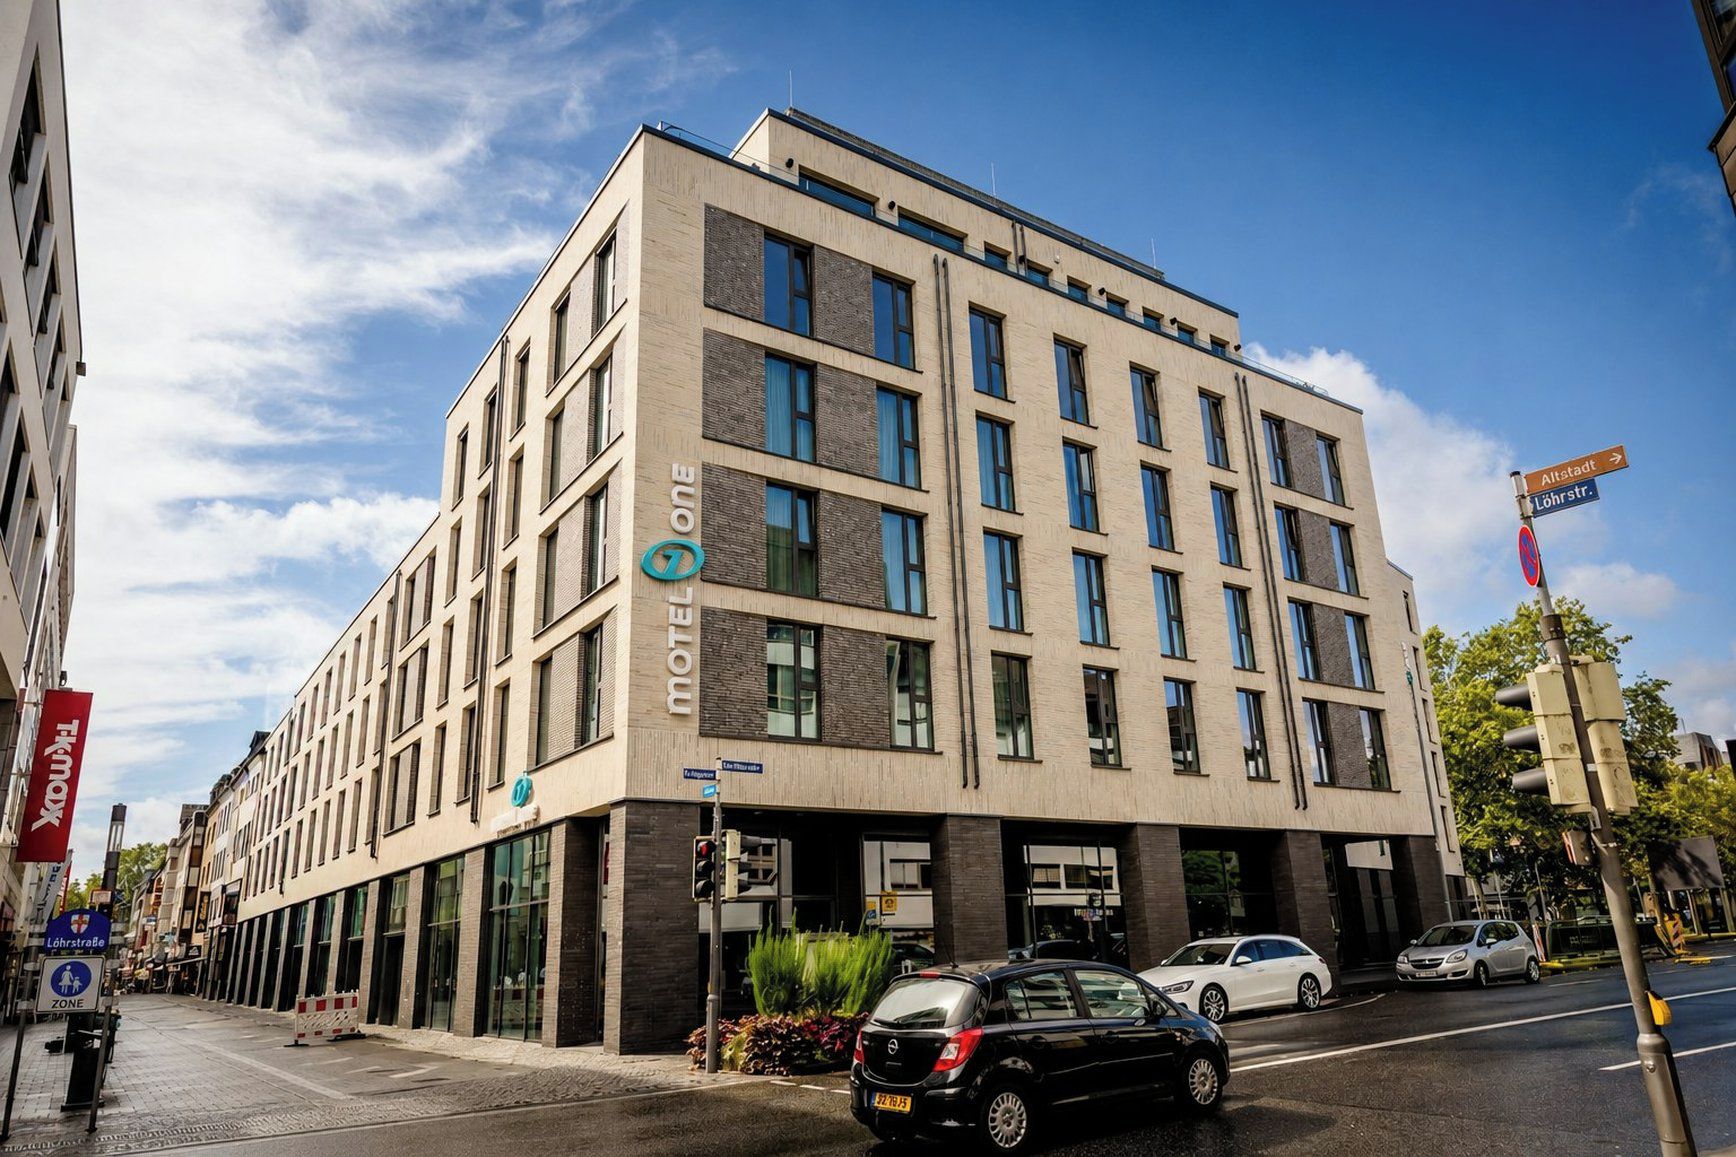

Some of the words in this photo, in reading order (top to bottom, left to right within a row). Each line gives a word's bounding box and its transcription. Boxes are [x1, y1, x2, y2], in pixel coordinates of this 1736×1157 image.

[1541, 459, 1597, 486] Altstadt
[1534, 485, 1593, 511] Löhrstr.
[46, 936, 106, 949] Löhrstraße
[51, 998, 84, 1009] ZONE
